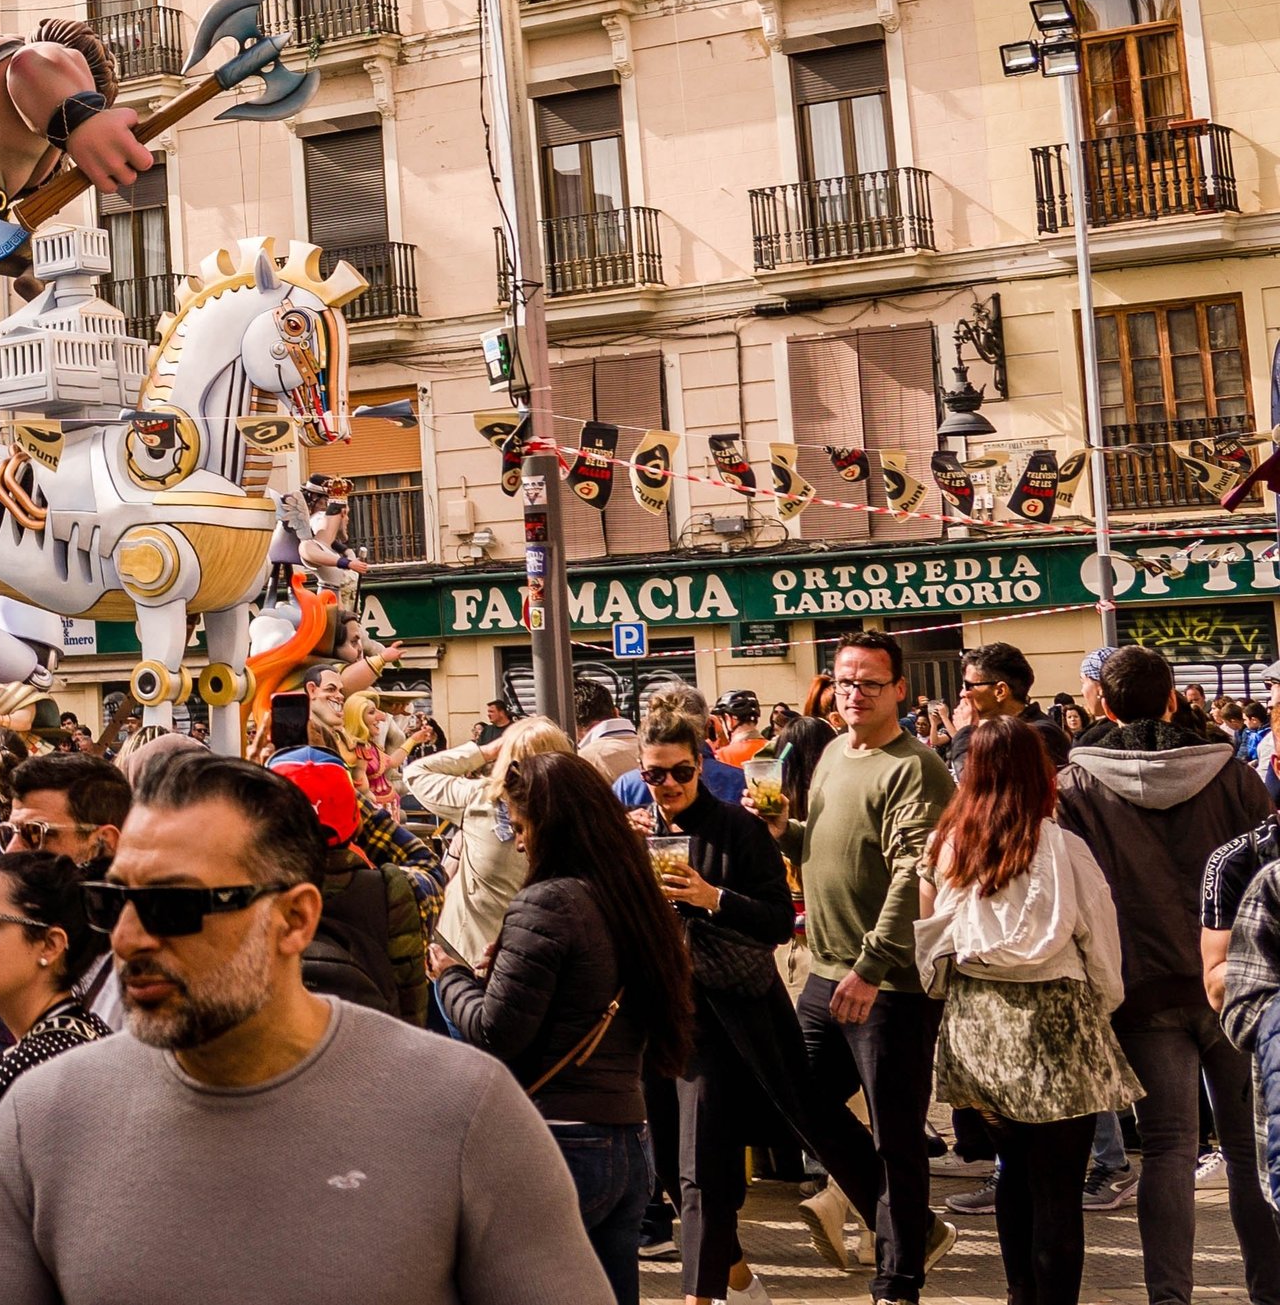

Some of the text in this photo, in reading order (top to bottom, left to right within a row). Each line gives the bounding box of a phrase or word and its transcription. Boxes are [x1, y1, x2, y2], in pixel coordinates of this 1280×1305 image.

[27, 444, 59, 468] Punt
[899, 483, 927, 514] Punt
[772, 555, 1040, 591] ORTOPEDIA
[451, 574, 739, 631] FAMACIA
[773, 580, 1041, 615] LABORATORIO
[620, 626, 640, 654] P
[1205, 843, 1233, 900] CALVIN KLEIN
